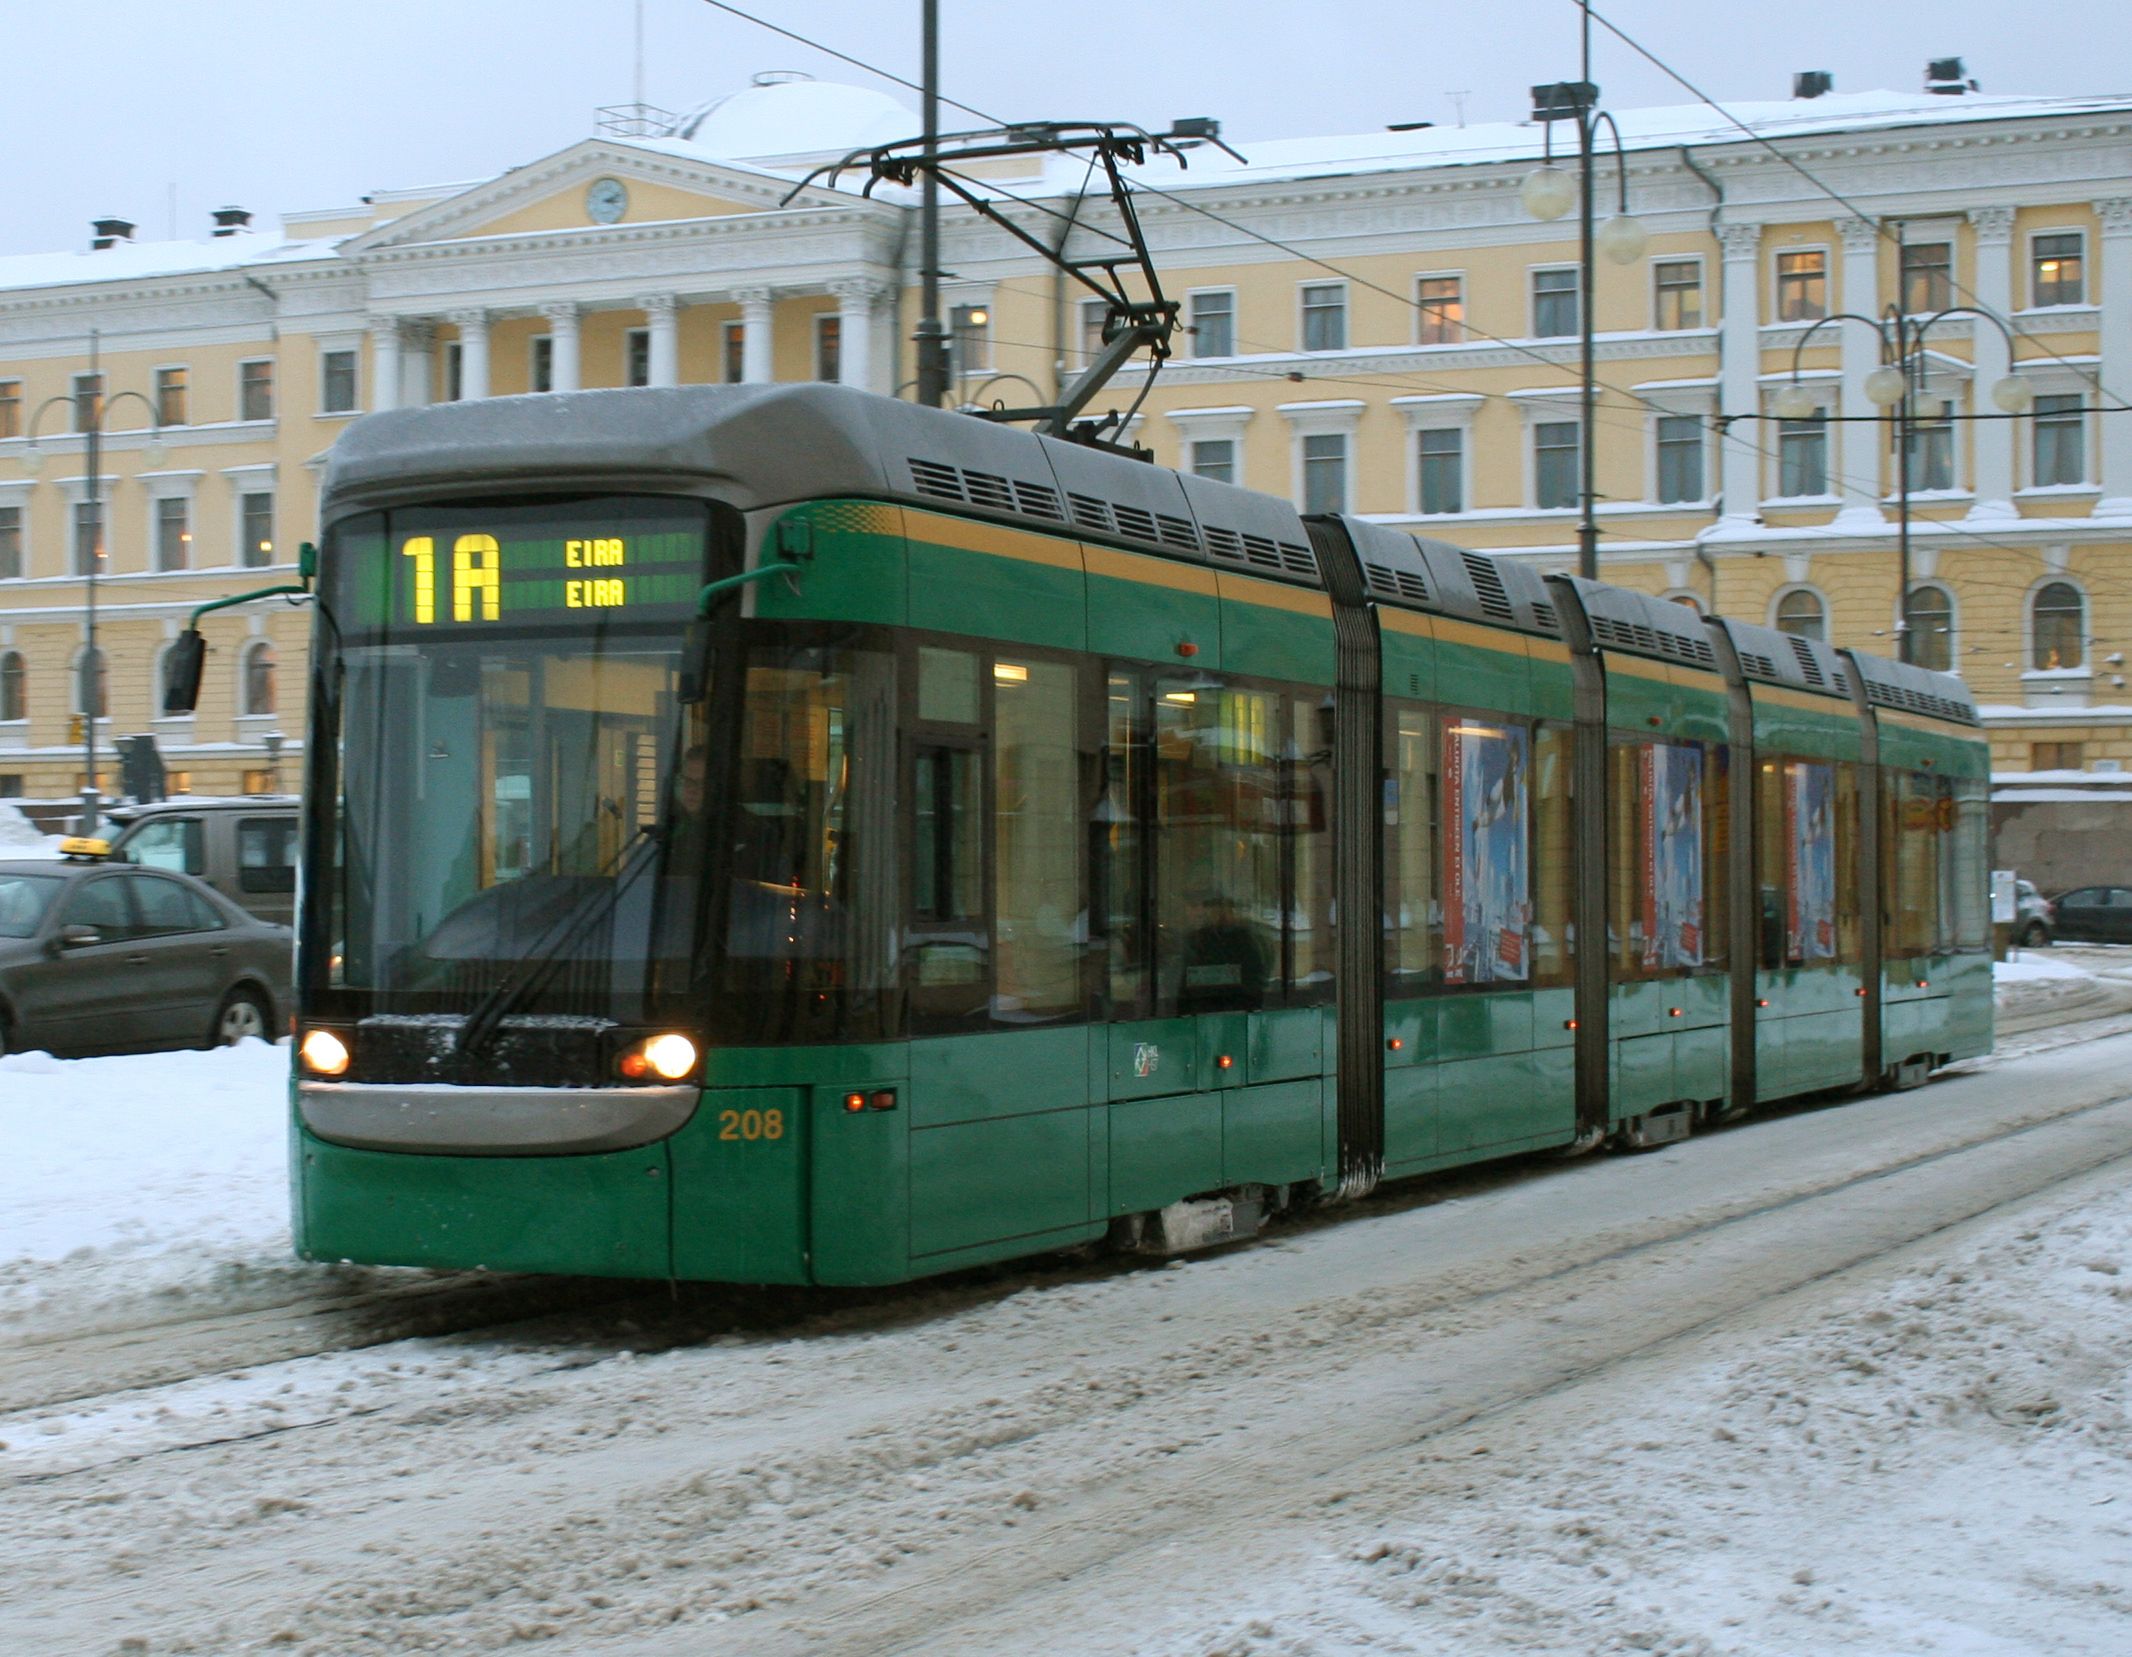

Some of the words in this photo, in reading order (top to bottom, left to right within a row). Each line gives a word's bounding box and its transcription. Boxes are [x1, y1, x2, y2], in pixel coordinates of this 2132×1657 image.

[565, 537, 624, 568] EIRA
[402, 534, 500, 624] 1A
[565, 578, 624, 608] EIRA
[719, 1110, 782, 1140] 208
